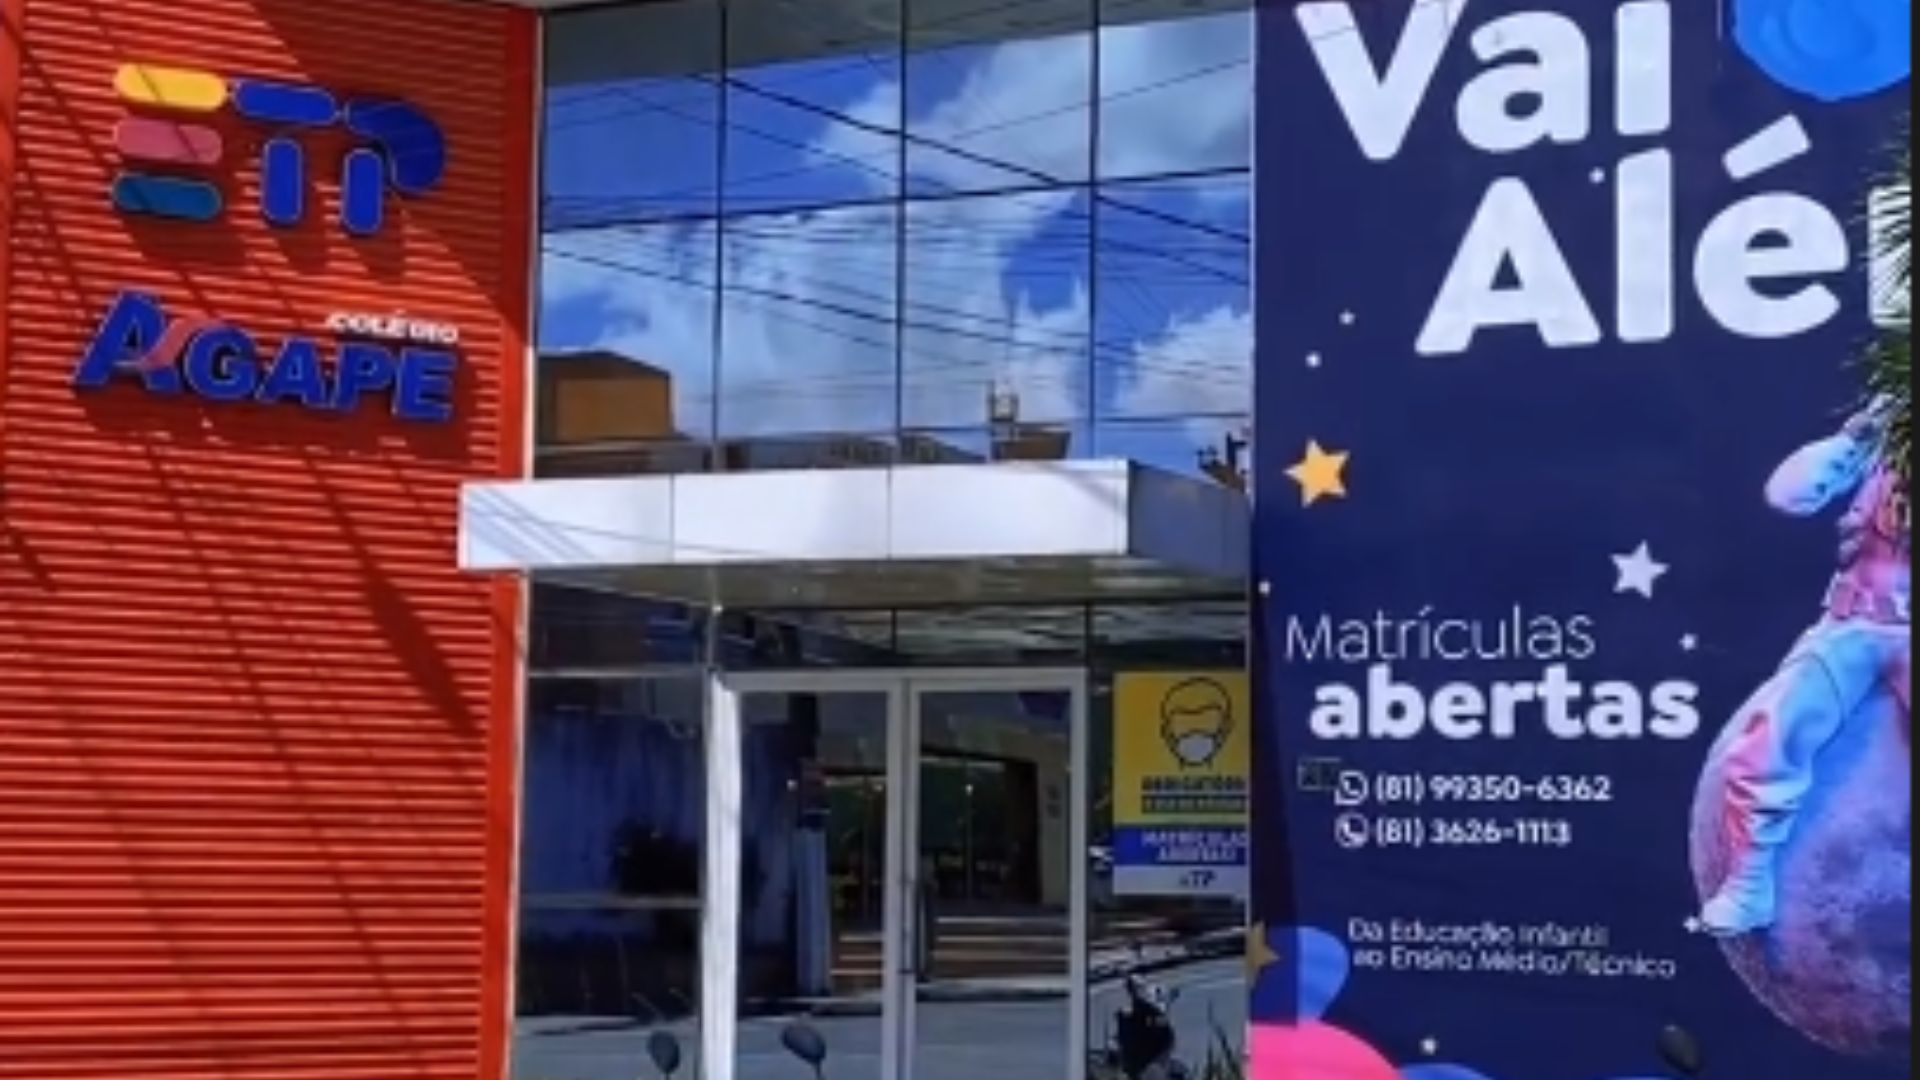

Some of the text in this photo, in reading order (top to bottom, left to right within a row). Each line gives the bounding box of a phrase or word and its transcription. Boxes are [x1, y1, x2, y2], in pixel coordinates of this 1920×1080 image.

[1294, 0, 1672, 160] Vai
[112, 62, 449, 235] ETP
[1285, 603, 1596, 662] Matrículas
[1309, 663, 1700, 740] abertas
[1375, 772, 1612, 804] (81) 99350-6362
[1375, 816, 1572, 848] (81) 3626-1113
[1348, 917, 1609, 950] Da Educação Infantil
[1353, 947, 1383, 967] ao
[1390, 946, 1472, 971] Ensino
